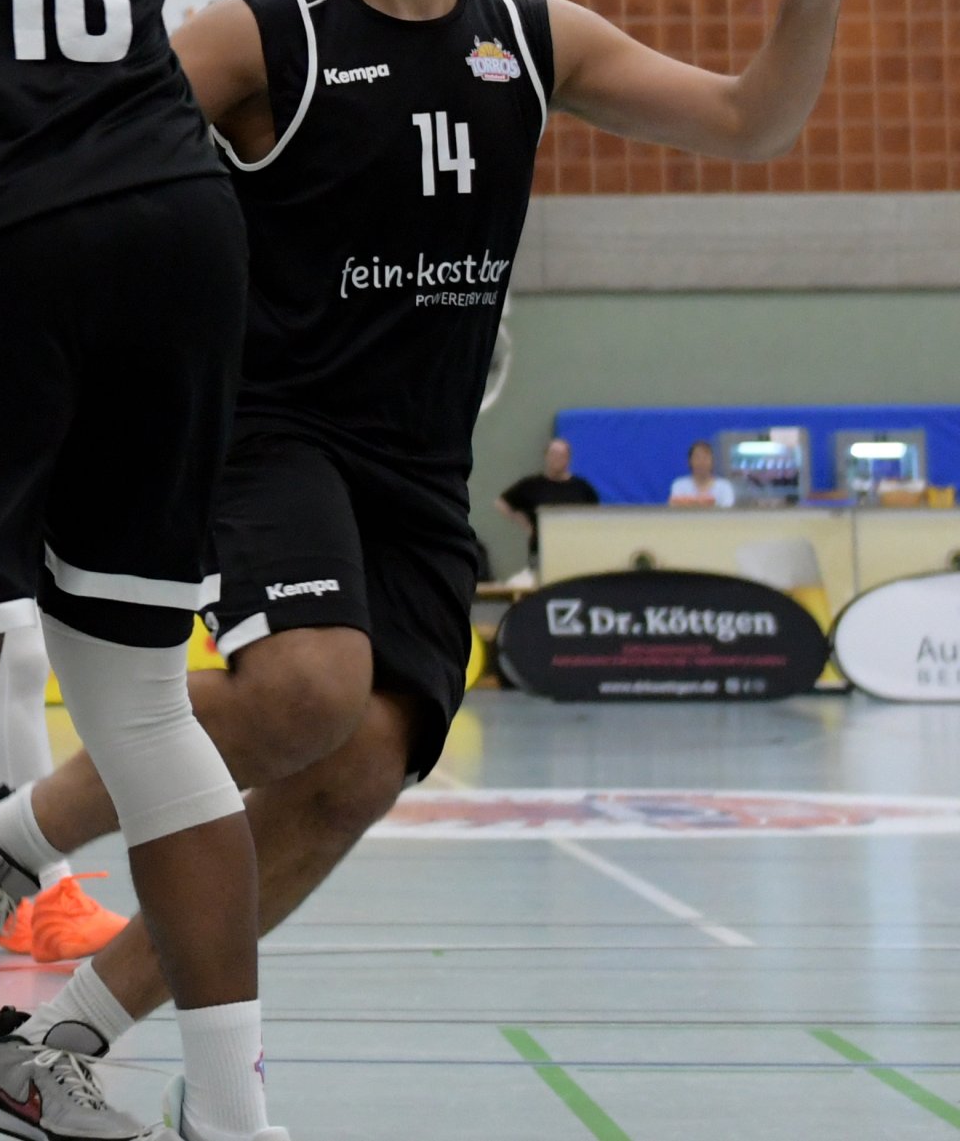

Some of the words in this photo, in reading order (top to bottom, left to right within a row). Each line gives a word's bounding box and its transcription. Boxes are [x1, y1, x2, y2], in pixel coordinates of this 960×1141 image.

[323, 63, 390, 86] Kempa
[412, 111, 476, 197] 14
[265, 579, 340, 600] Kempa
[589, 607, 641, 635] Dr.
[645, 606, 778, 643] Köttgen
